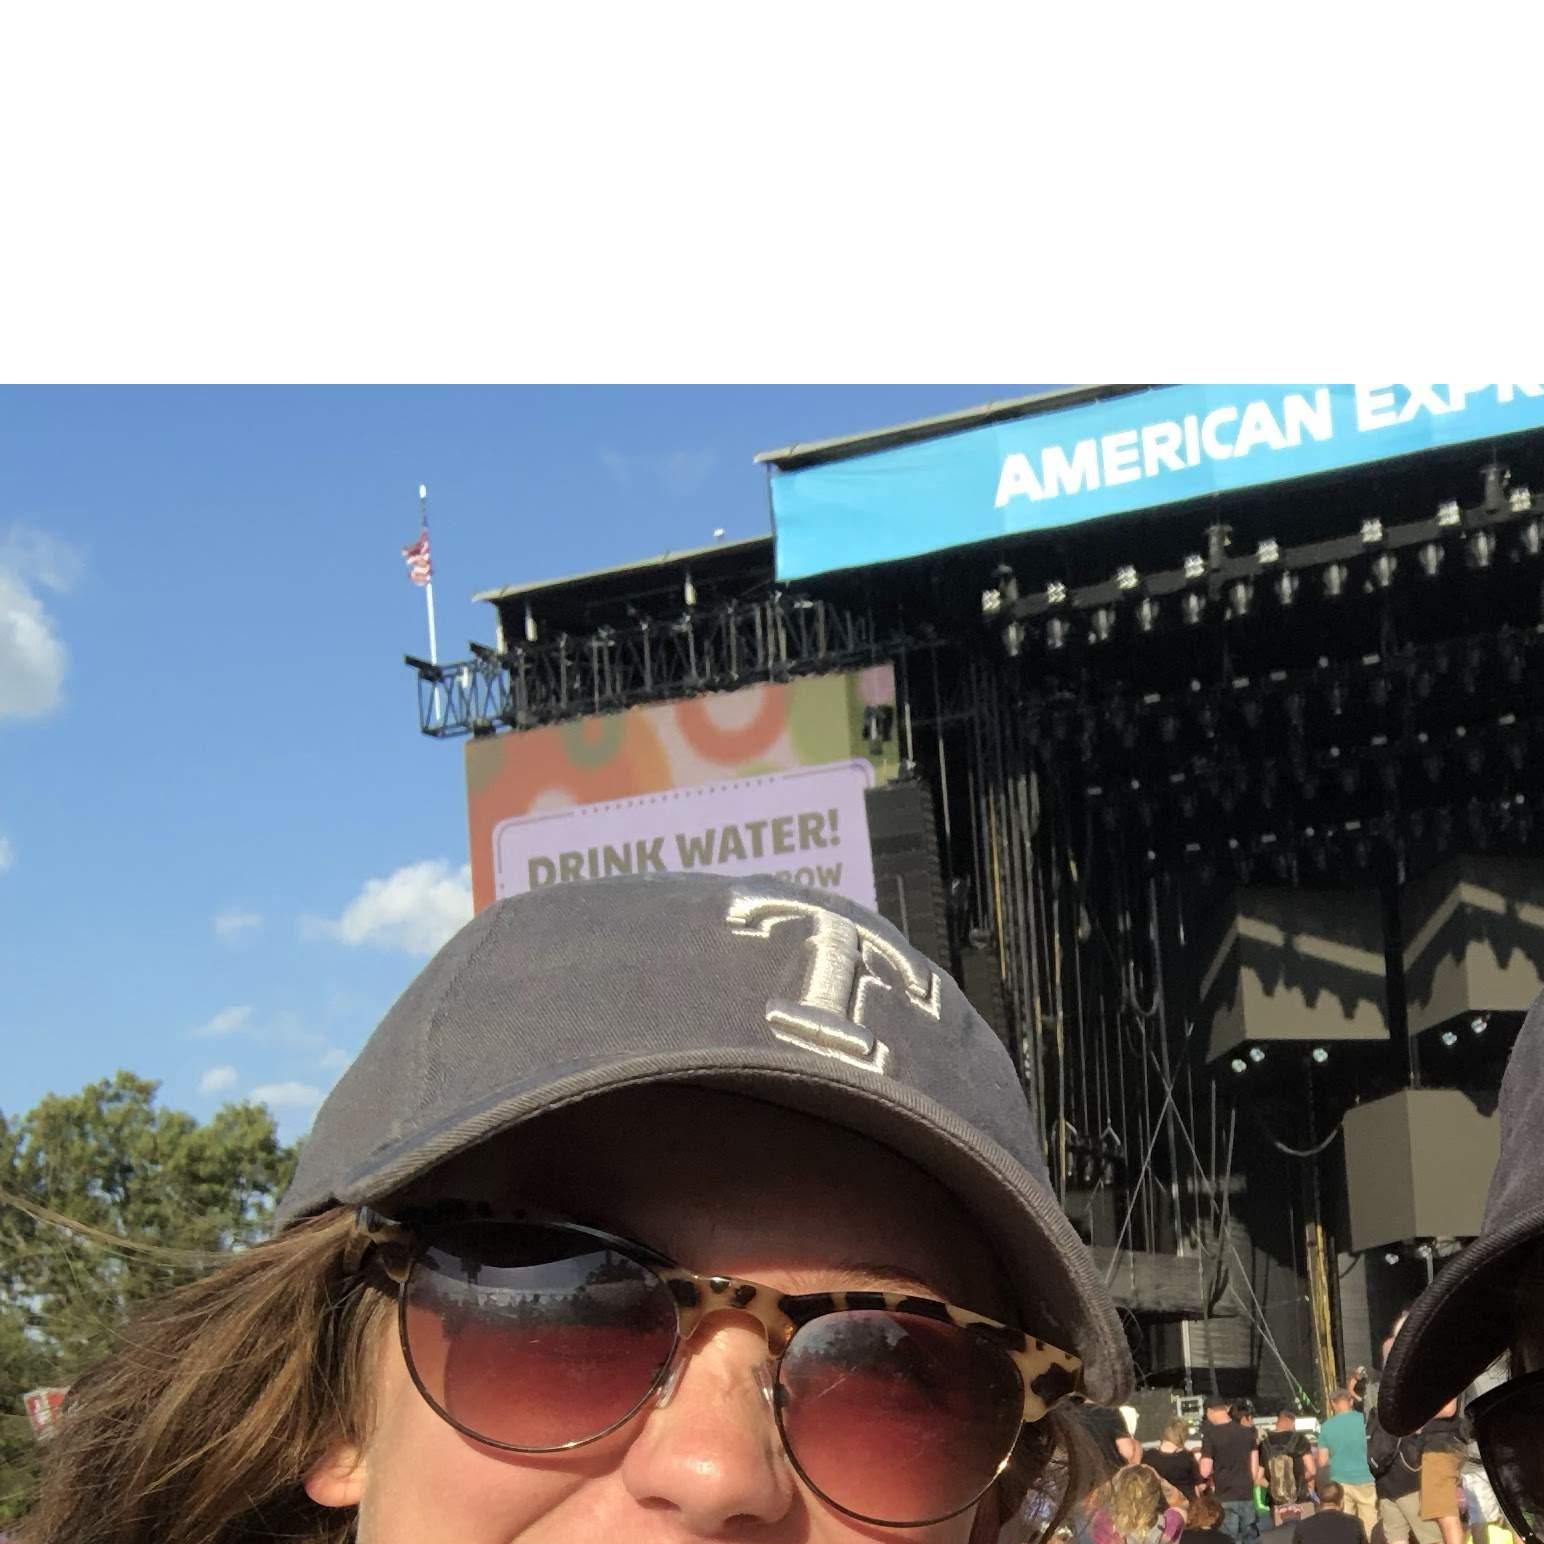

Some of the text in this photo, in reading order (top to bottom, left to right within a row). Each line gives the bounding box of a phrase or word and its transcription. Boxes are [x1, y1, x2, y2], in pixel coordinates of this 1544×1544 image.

[995, 386, 1334, 508] AMERICAN
[527, 807, 841, 891] DRINK WATER!
